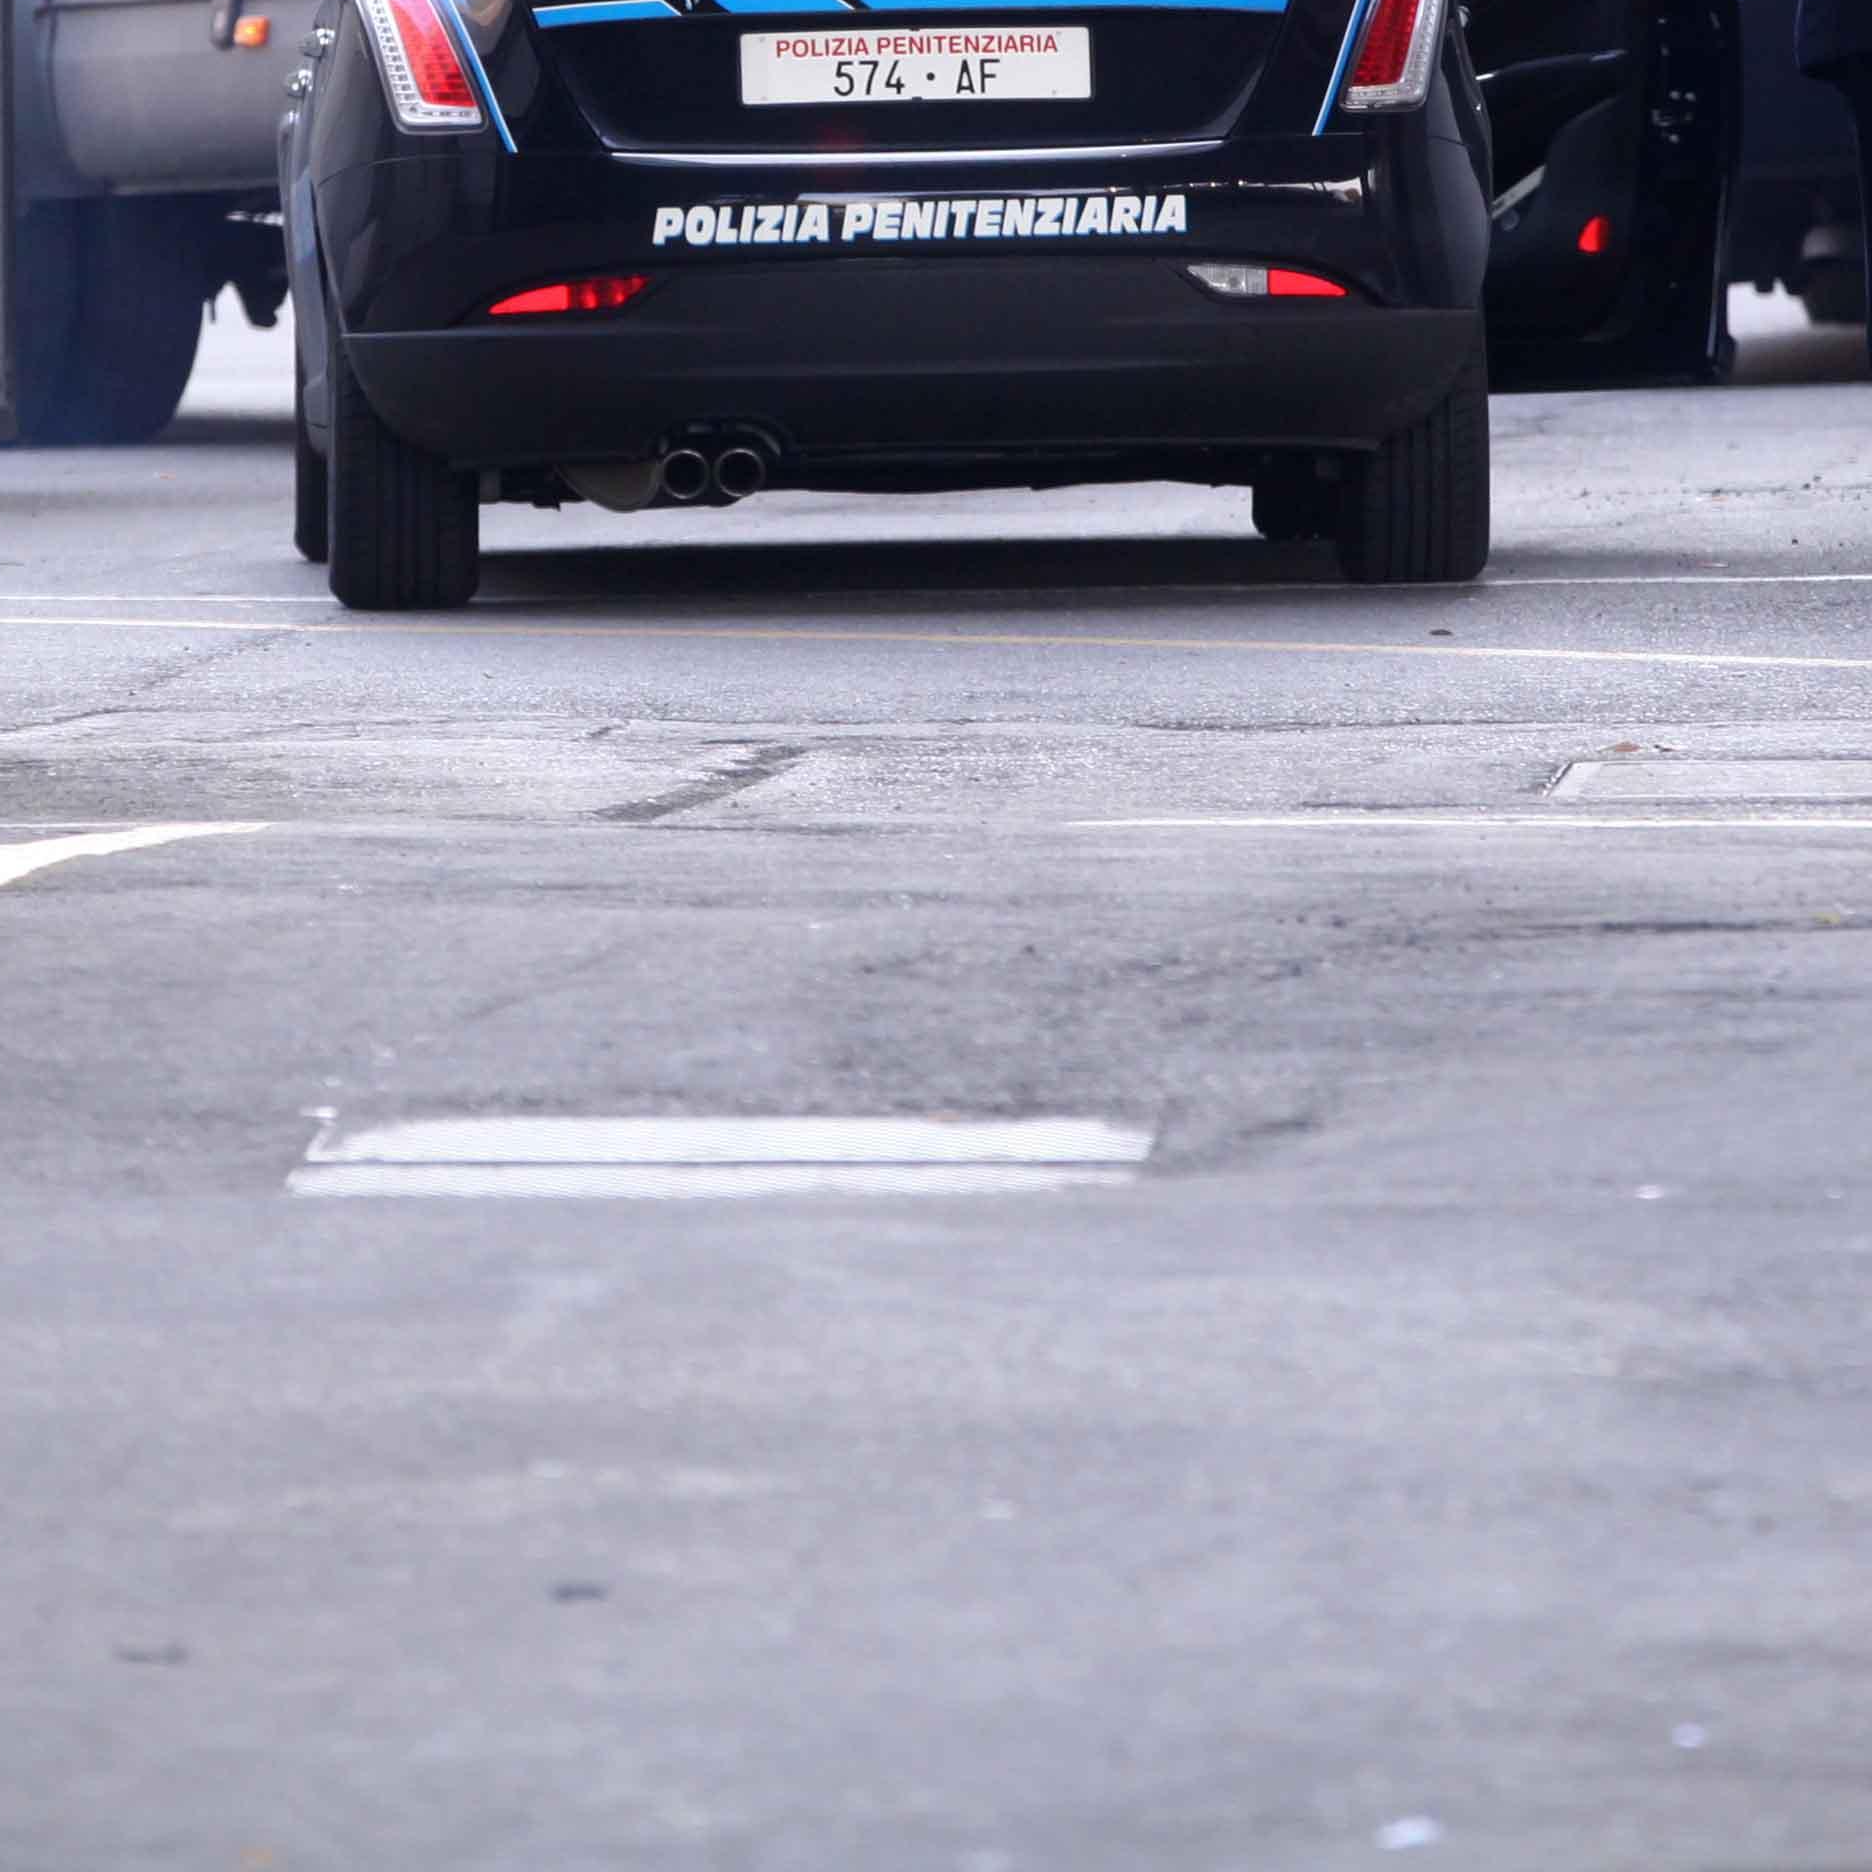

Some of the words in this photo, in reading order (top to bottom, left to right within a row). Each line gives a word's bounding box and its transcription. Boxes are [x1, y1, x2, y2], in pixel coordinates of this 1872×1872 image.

[775, 37, 869, 59] POLIZIA
[876, 34, 1059, 56] PENITENZIARIA
[833, 59, 905, 97] 574
[955, 58, 1001, 95] AF
[651, 205, 829, 245] POLIZIA
[841, 194, 1187, 240] PENITENZIARIA
